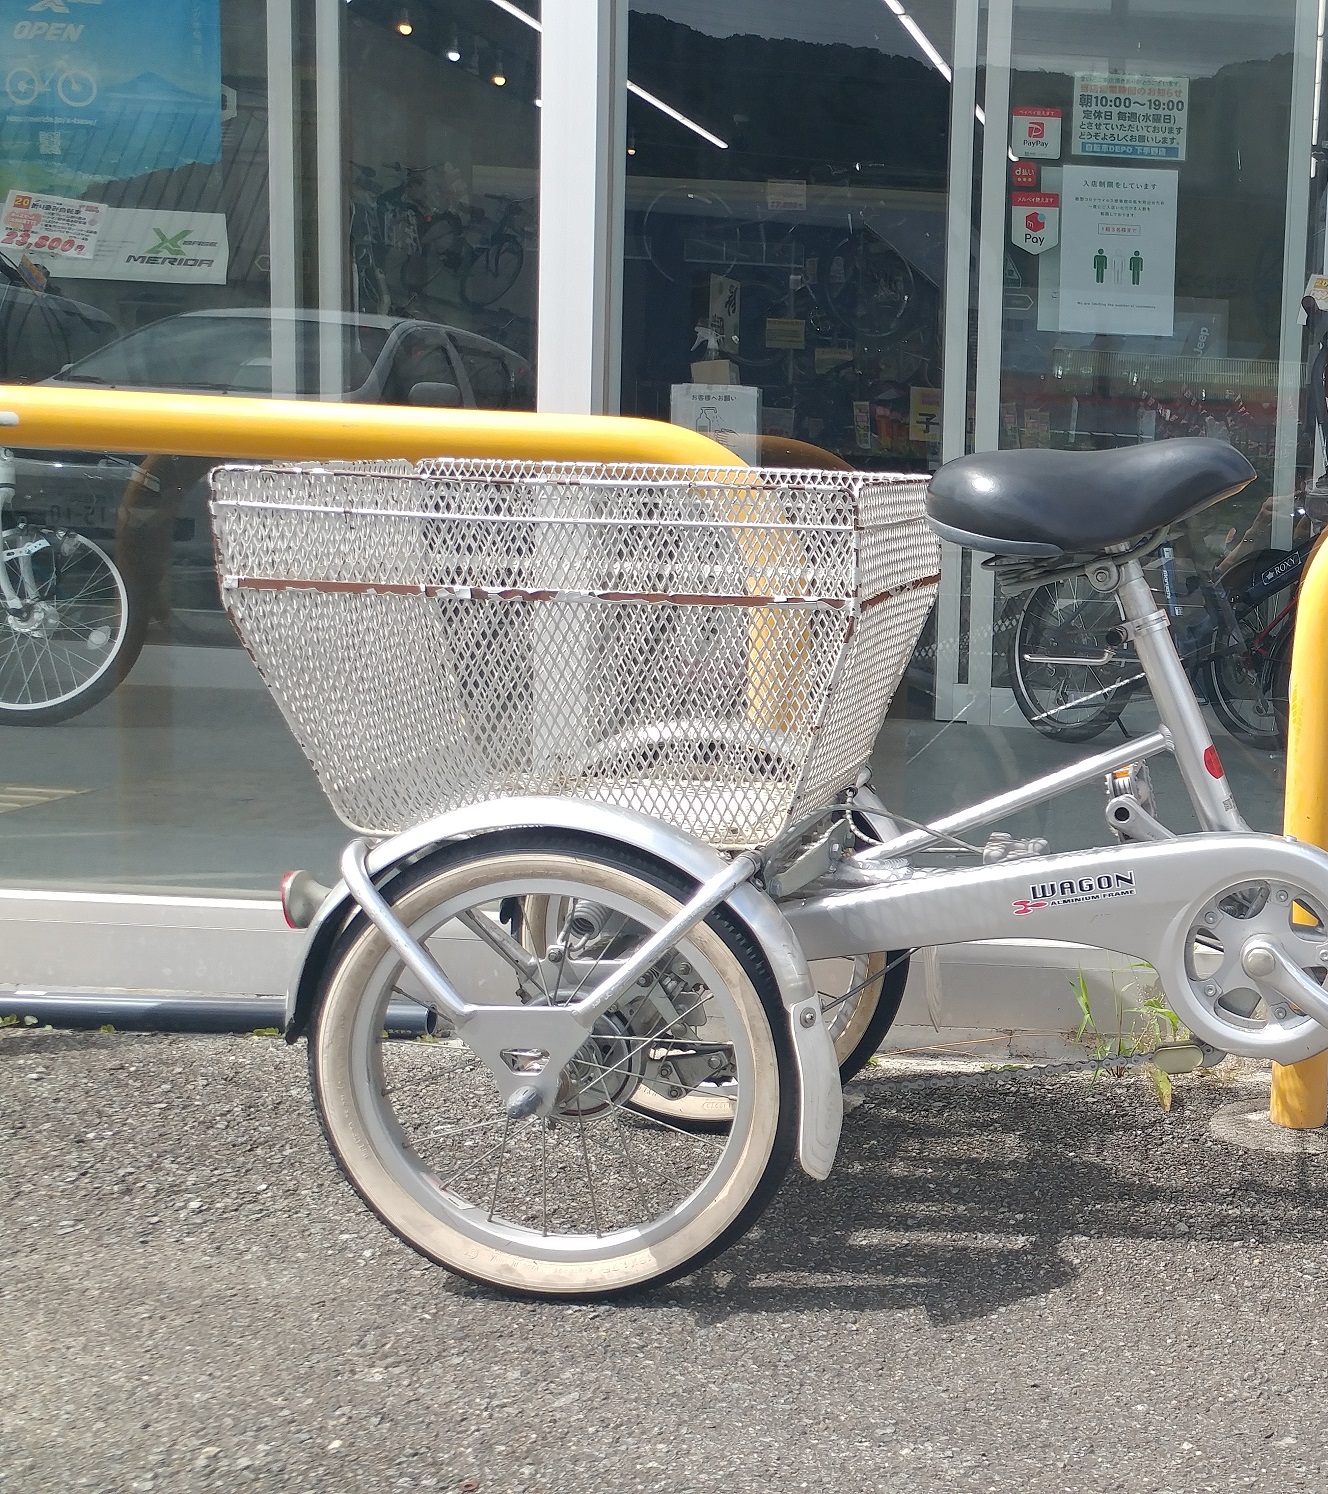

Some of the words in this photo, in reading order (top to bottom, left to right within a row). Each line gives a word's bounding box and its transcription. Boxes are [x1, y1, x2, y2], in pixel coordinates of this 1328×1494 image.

[13, 20, 85, 42] OPEN
[1082, 109, 1113, 121] 定休日
[1079, 121, 1184, 136] とさせていただいております
[1023, 139, 1049, 149] PayPay
[1082, 180, 1158, 191] 入店制限をしています
[15, 198, 30, 206] 20
[1024, 233, 1046, 247] Pay
[125, 255, 215, 268] MERIDA
[691, 394, 738, 402] お客様へお願い
[1274, 556, 1297, 576] ROXY
[1031, 871, 1135, 900] WAGON
[1050, 894, 1101, 906] ALMINIUM
[1102, 888, 1136, 899] FRAME
